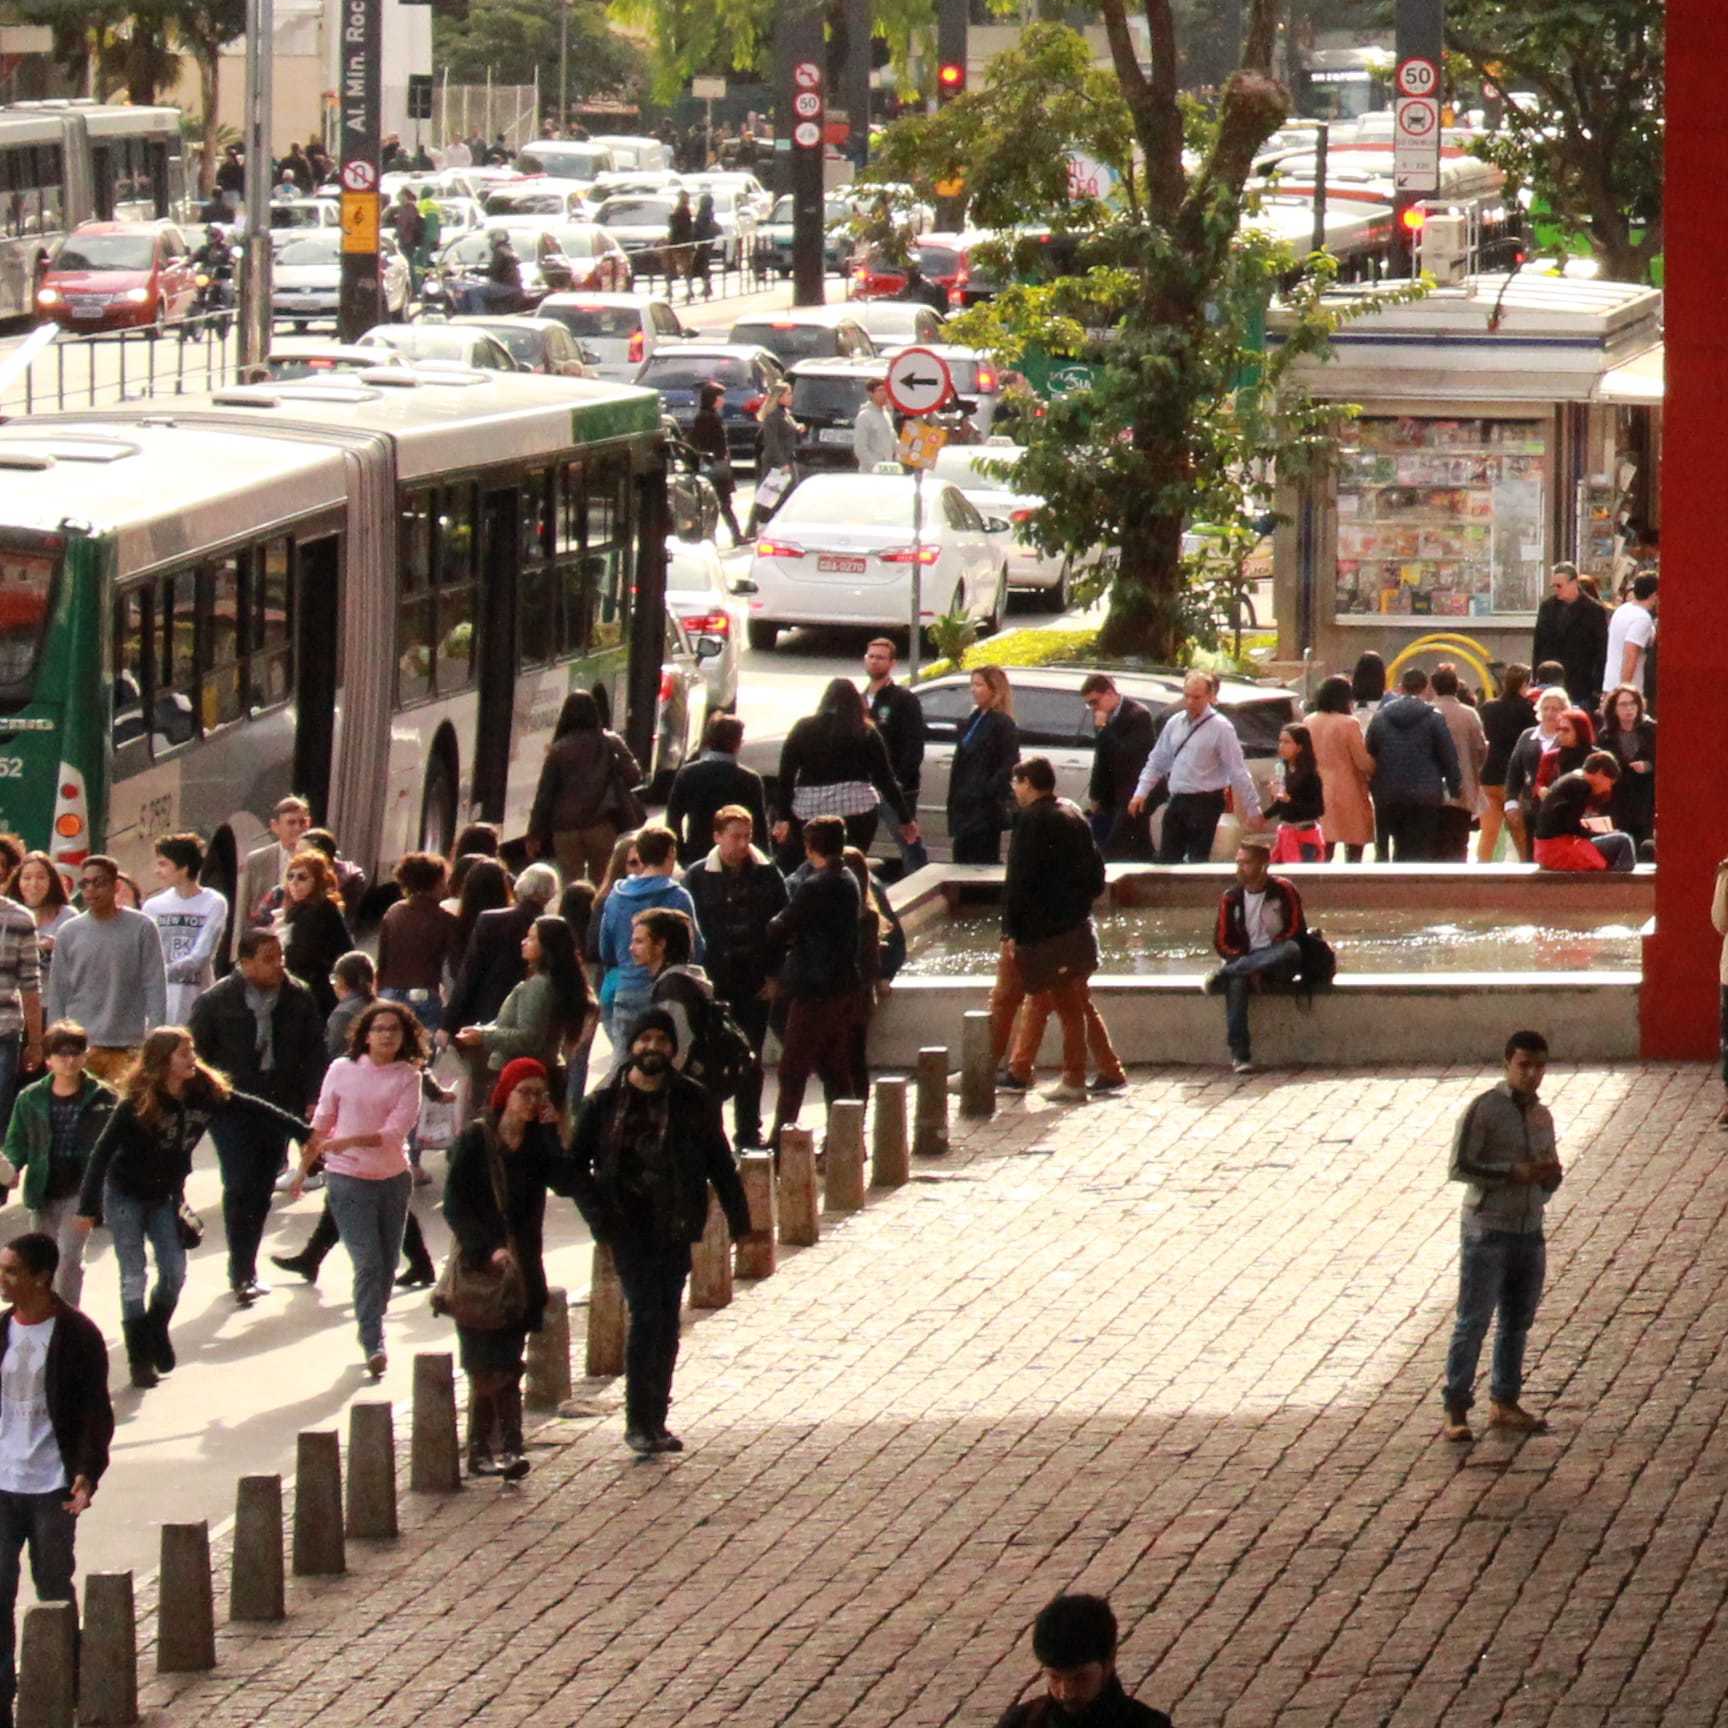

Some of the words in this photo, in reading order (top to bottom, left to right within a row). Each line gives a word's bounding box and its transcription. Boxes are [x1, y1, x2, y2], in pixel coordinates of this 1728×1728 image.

[346, 52, 366, 98] Min.
[1405, 67, 1431, 85] 50
[346, 104, 366, 133] Al.
